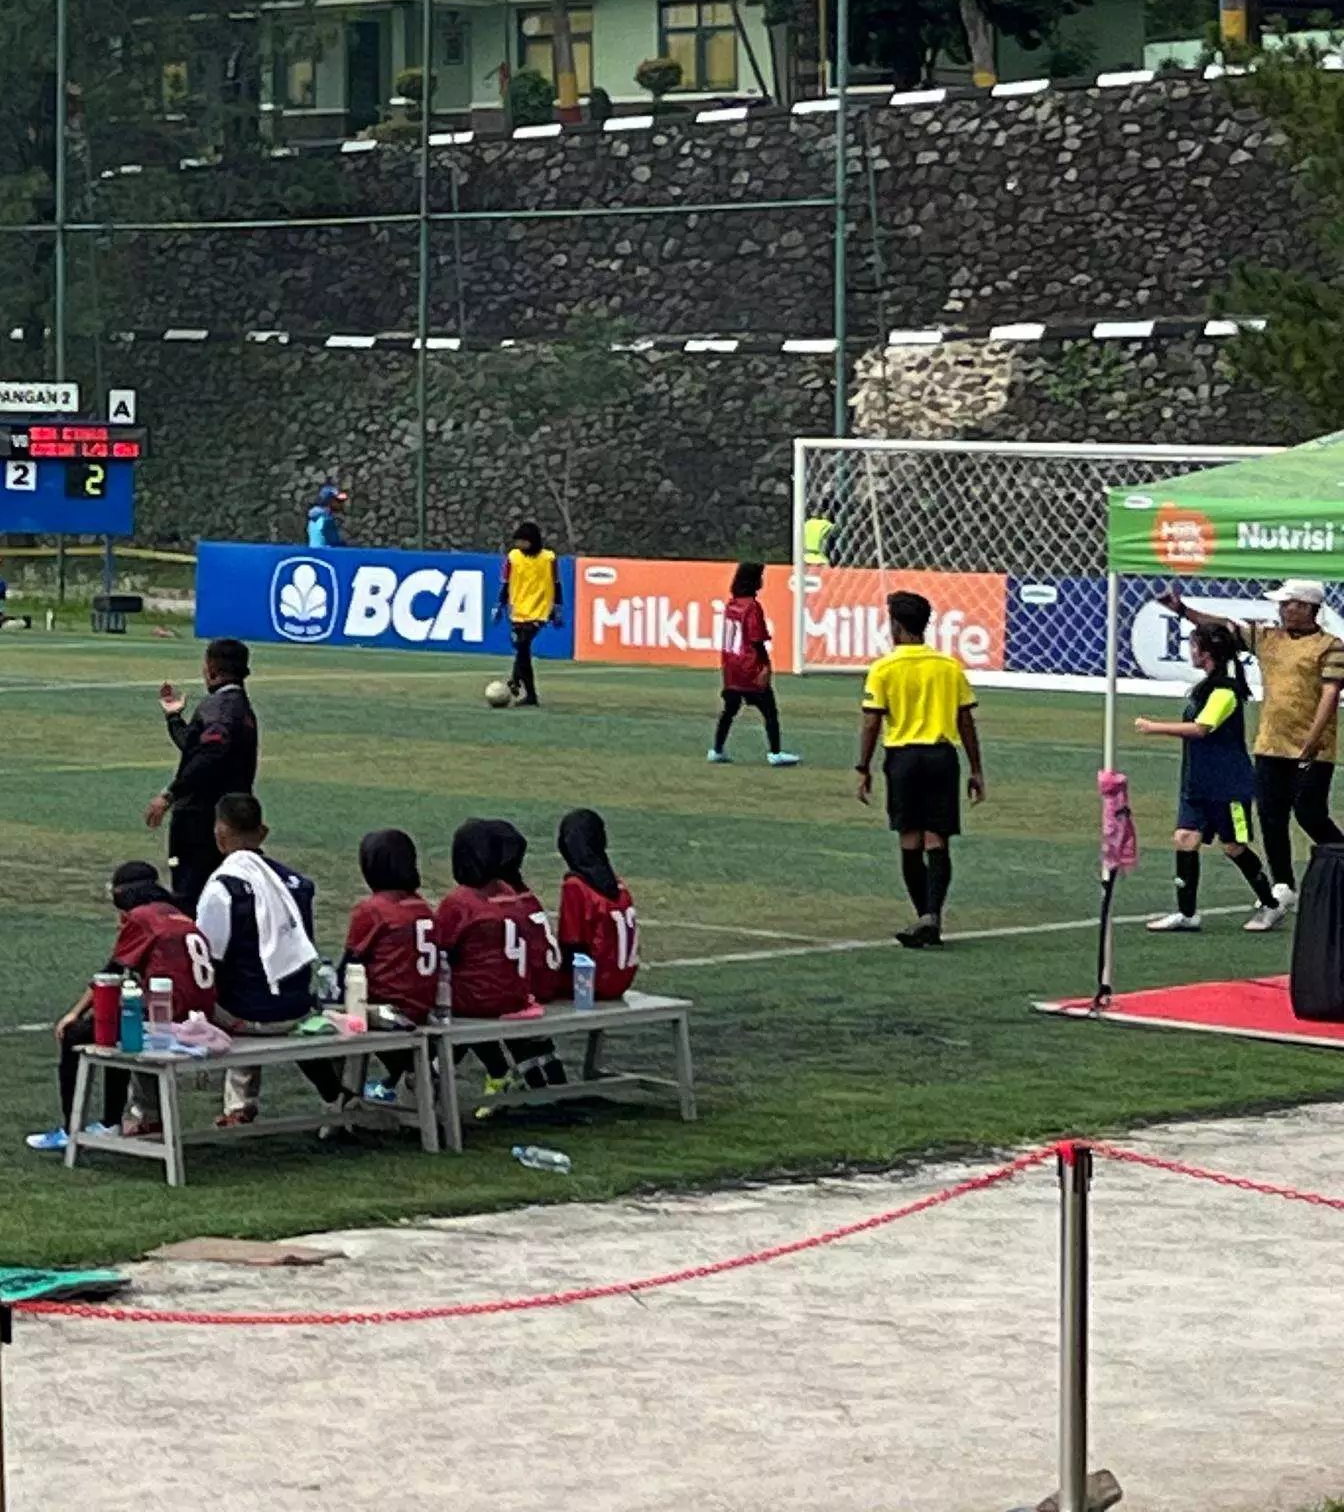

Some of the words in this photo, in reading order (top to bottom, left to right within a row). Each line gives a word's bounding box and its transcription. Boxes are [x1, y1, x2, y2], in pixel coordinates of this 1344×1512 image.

[61, 391, 71, 404] 2
[113, 399, 130, 418] A
[12, 464, 30, 486] 2
[84, 463, 105, 495] 2
[1236, 520, 1335, 552] Nutrisi
[343, 566, 484, 643] BCA
[802, 604, 991, 664] Milkife
[185, 933, 215, 989] 8
[416, 918, 437, 976] 5
[504, 917, 527, 978] 4
[610, 906, 637, 971] 12
